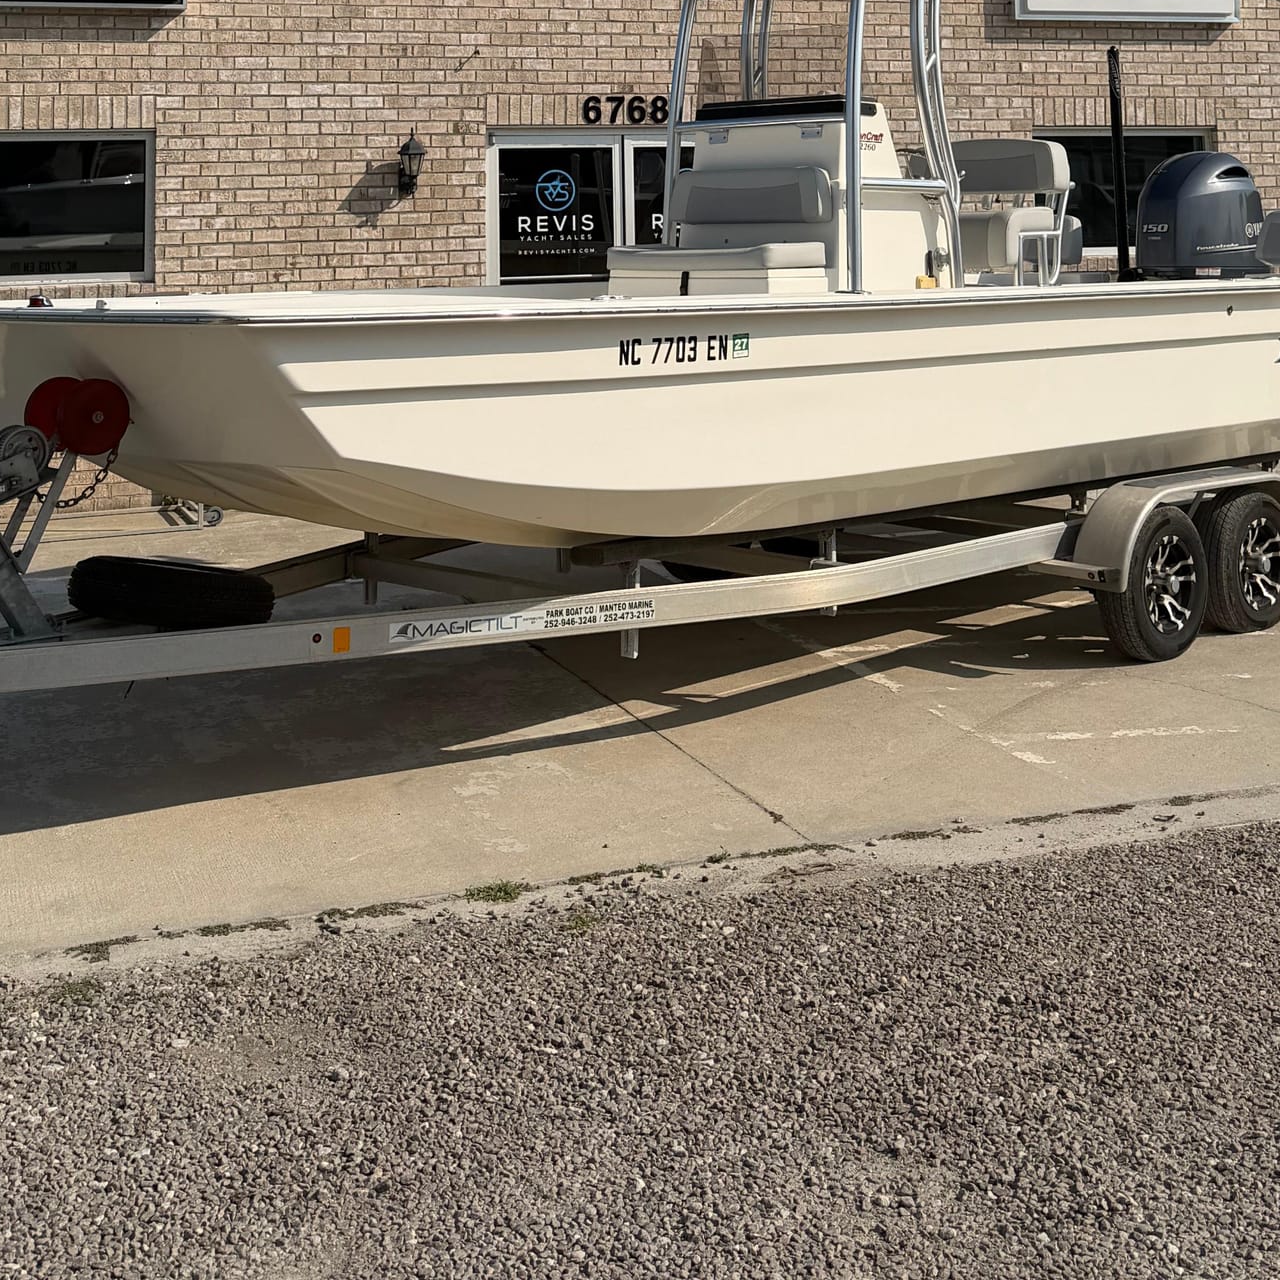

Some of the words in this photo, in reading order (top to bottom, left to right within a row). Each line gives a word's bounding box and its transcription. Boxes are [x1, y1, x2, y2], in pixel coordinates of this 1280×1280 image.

[583, 96, 669, 124] 6768
[518, 214, 594, 232] REVIS
[1142, 223, 1169, 233] 150
[560, 233, 593, 241] SALES
[518, 247, 595, 256] REVISYACHTS.COM
[619, 338, 642, 365] NC
[651, 335, 698, 364] 7703
[707, 334, 728, 361] EN
[734, 338, 748, 351] 27
[544, 615, 597, 628] 252-946-3248
[604, 609, 655, 623] 252-473-2197
[546, 609, 564, 619] PARK
[565, 607, 583, 617] BOAT
[584, 605, 595, 614] CO
[599, 602, 627, 613] MANTEO
[628, 600, 654, 609] MARINE
[412, 615, 523, 639] MAGICTILT
